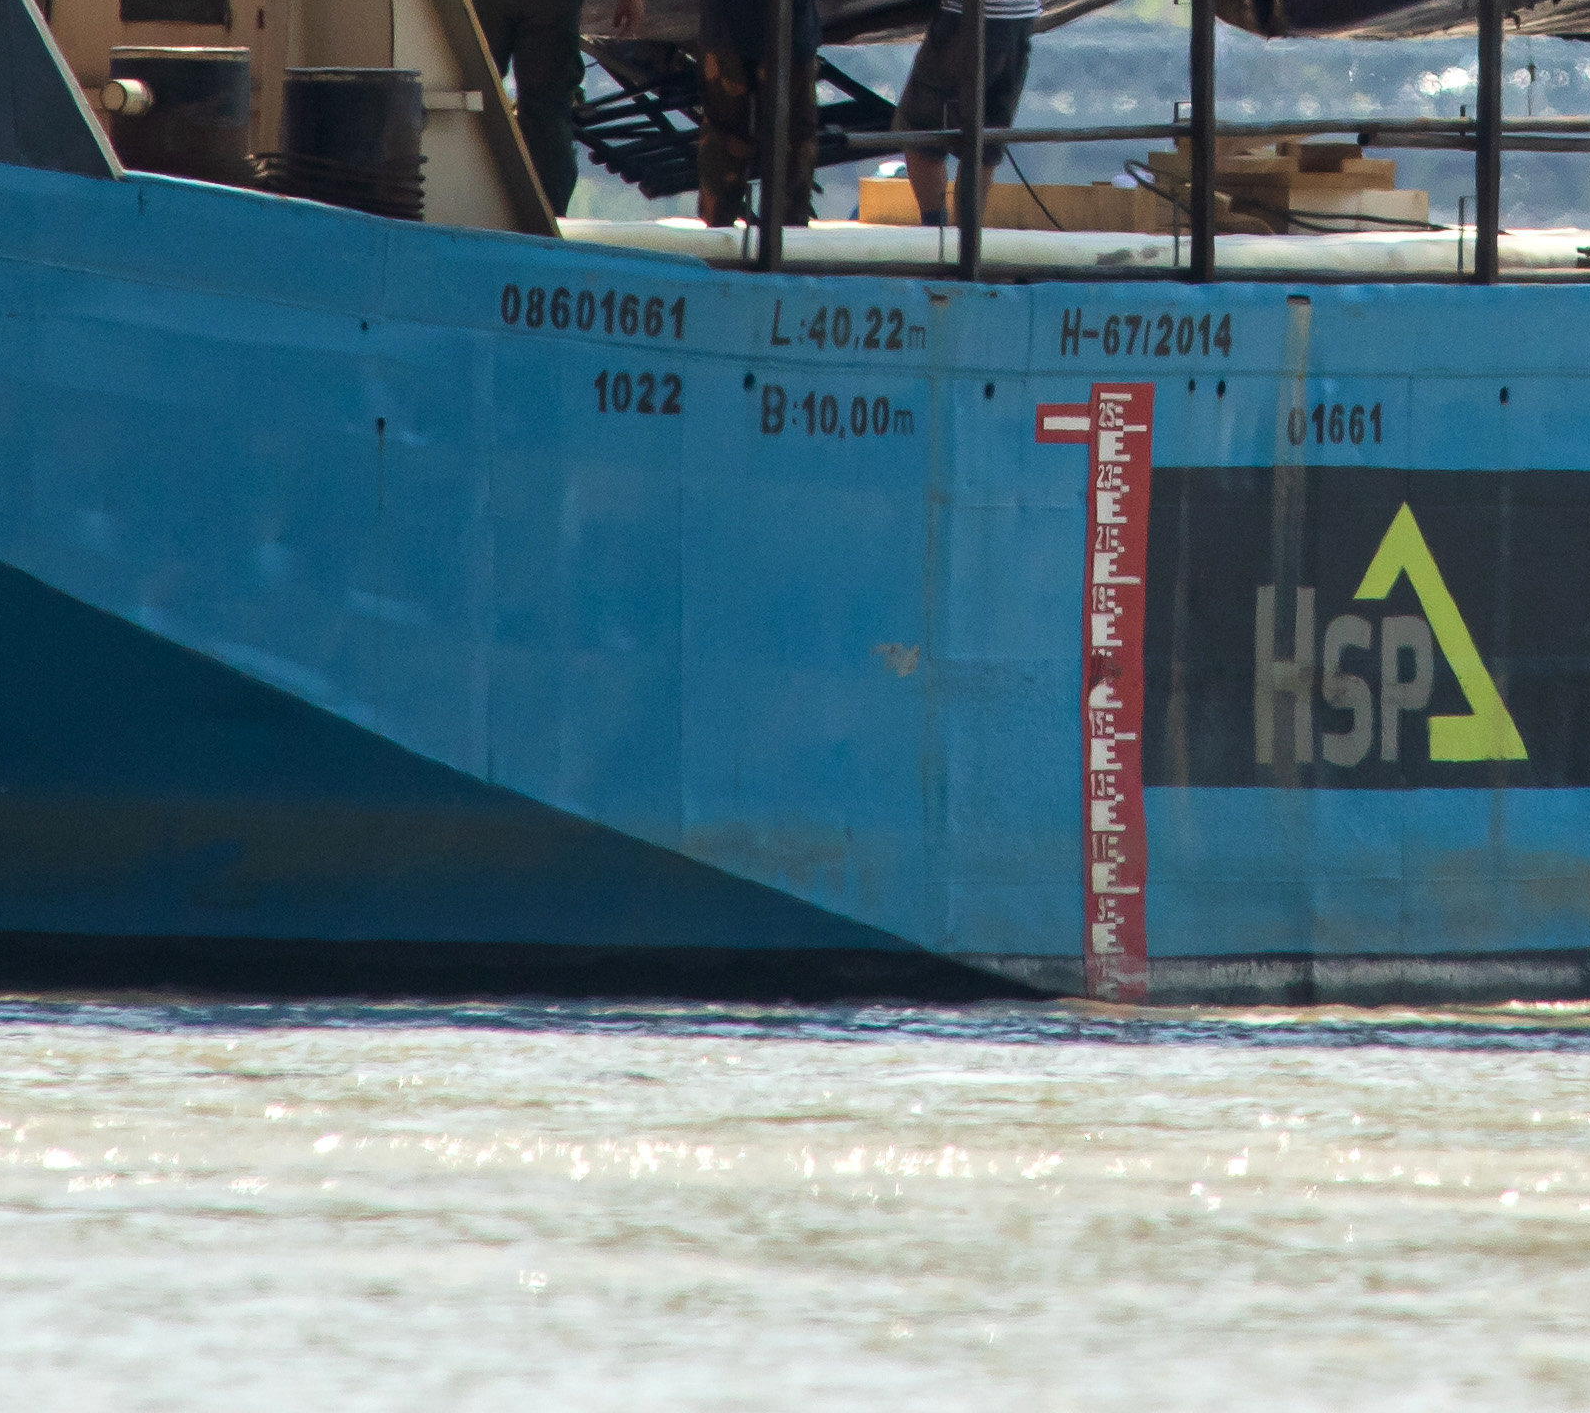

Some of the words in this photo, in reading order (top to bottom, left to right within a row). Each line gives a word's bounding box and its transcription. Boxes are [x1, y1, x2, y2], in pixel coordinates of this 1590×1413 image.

[500, 283, 687, 341] 08601661
[1060, 308, 1233, 357] H-67/2014
[594, 369, 683, 415] 1022
[1287, 402, 1383, 446] 01661
[1255, 585, 1434, 768] HSP
